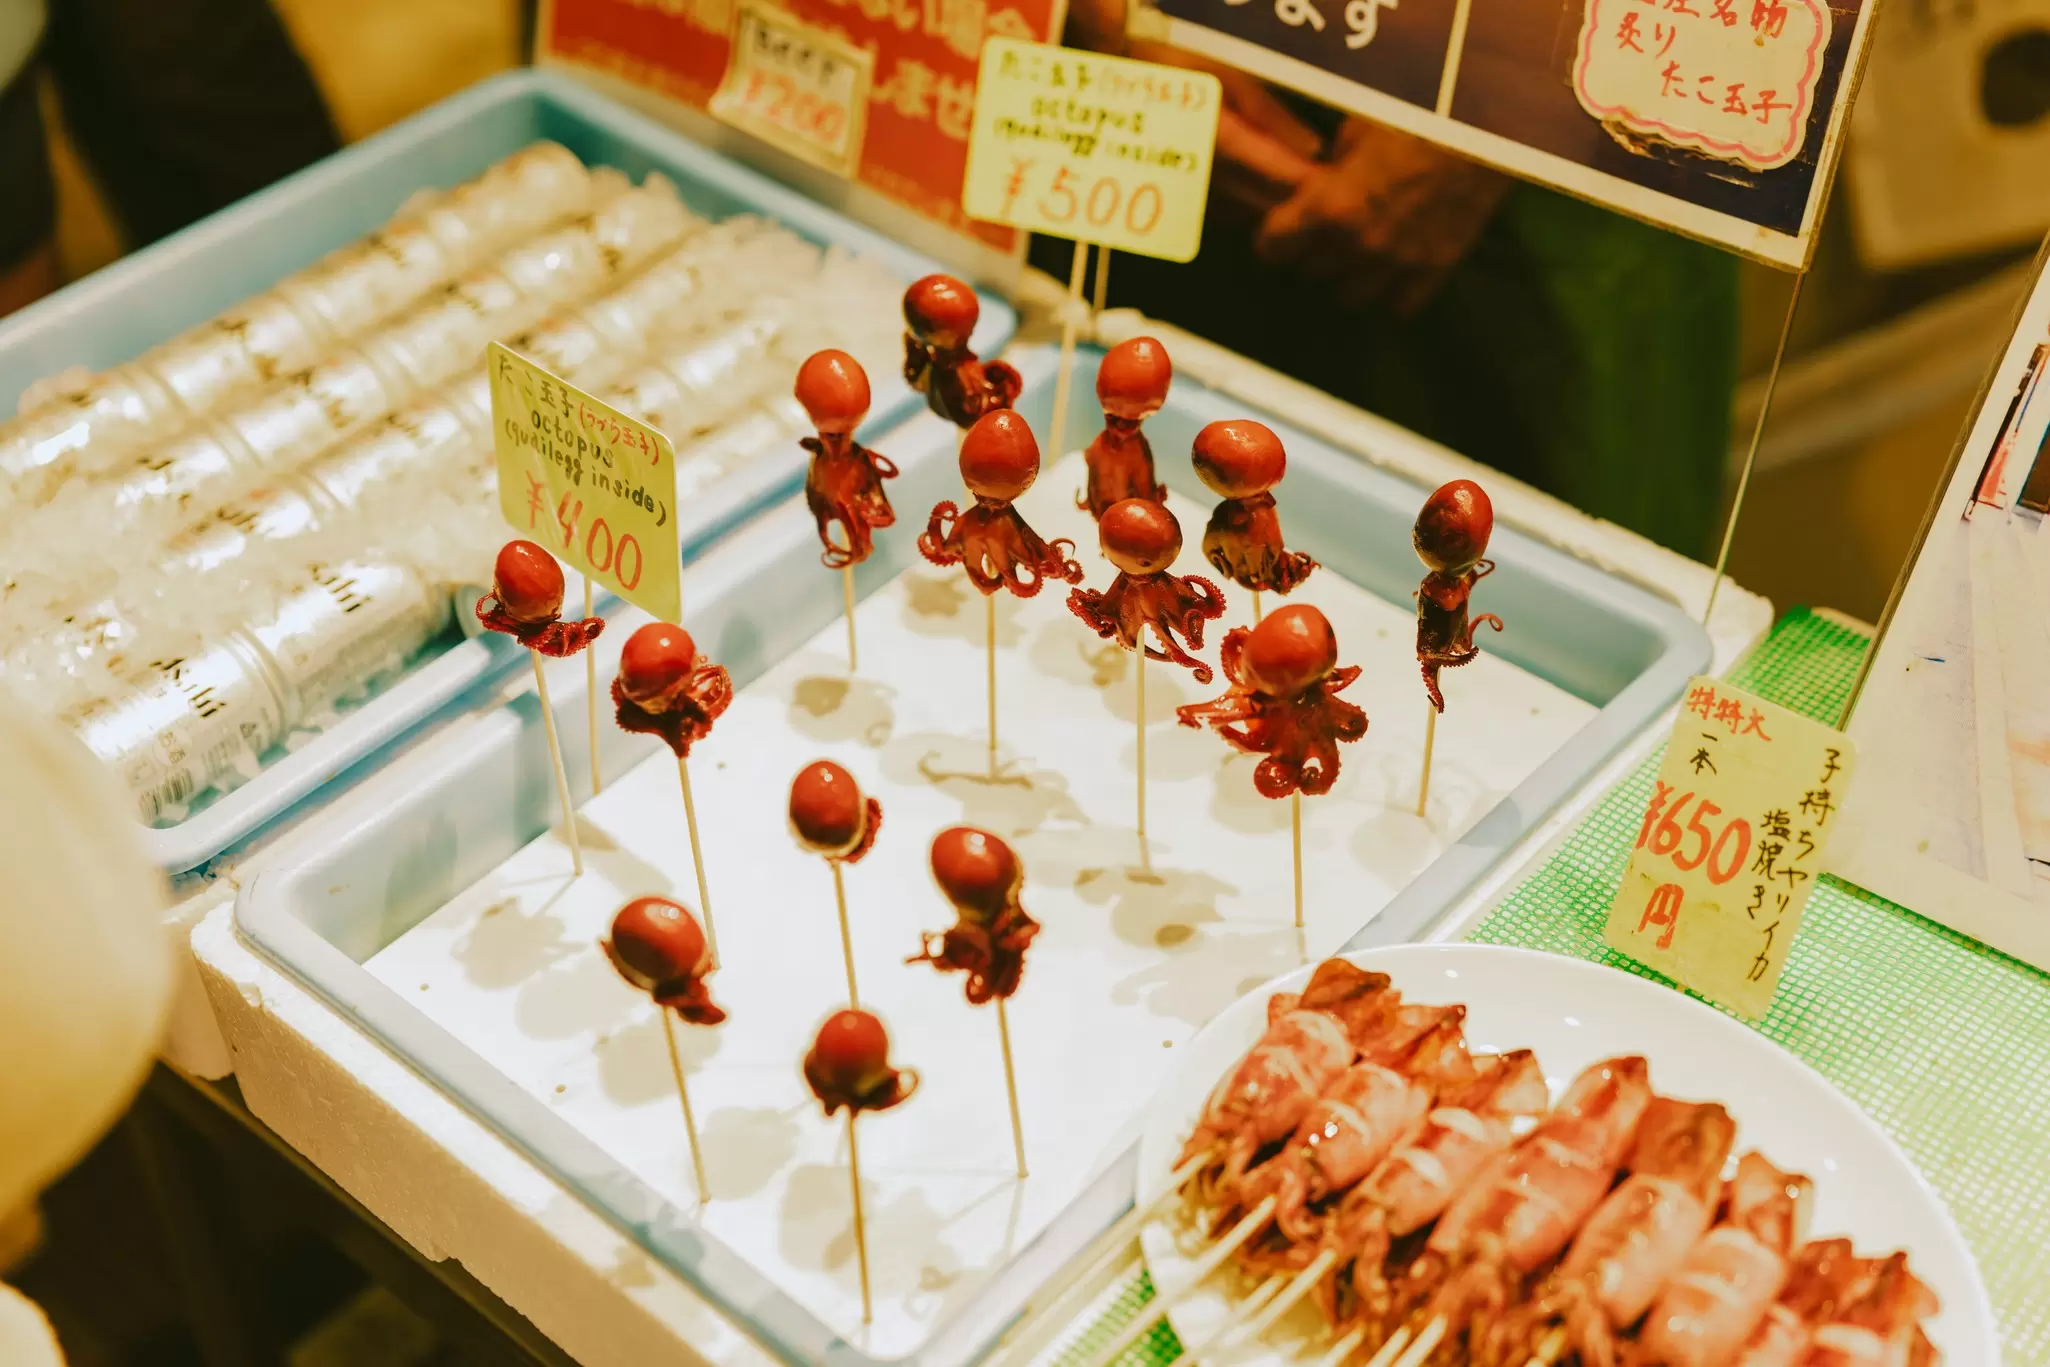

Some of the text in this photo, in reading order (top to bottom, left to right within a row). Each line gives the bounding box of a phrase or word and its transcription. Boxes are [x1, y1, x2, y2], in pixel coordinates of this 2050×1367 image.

[1660, 60, 1793, 125] たこ玉子
[1001, 157, 1164, 236] ¥500
[530, 409, 614, 469] octopus
[525, 469, 643, 592] ¥400
[1686, 686, 1772, 742] 特特大
[1635, 779, 1752, 885] ¥650
[1746, 808, 1791, 920] 塩焼き
[1637, 882, 1686, 951] 円
